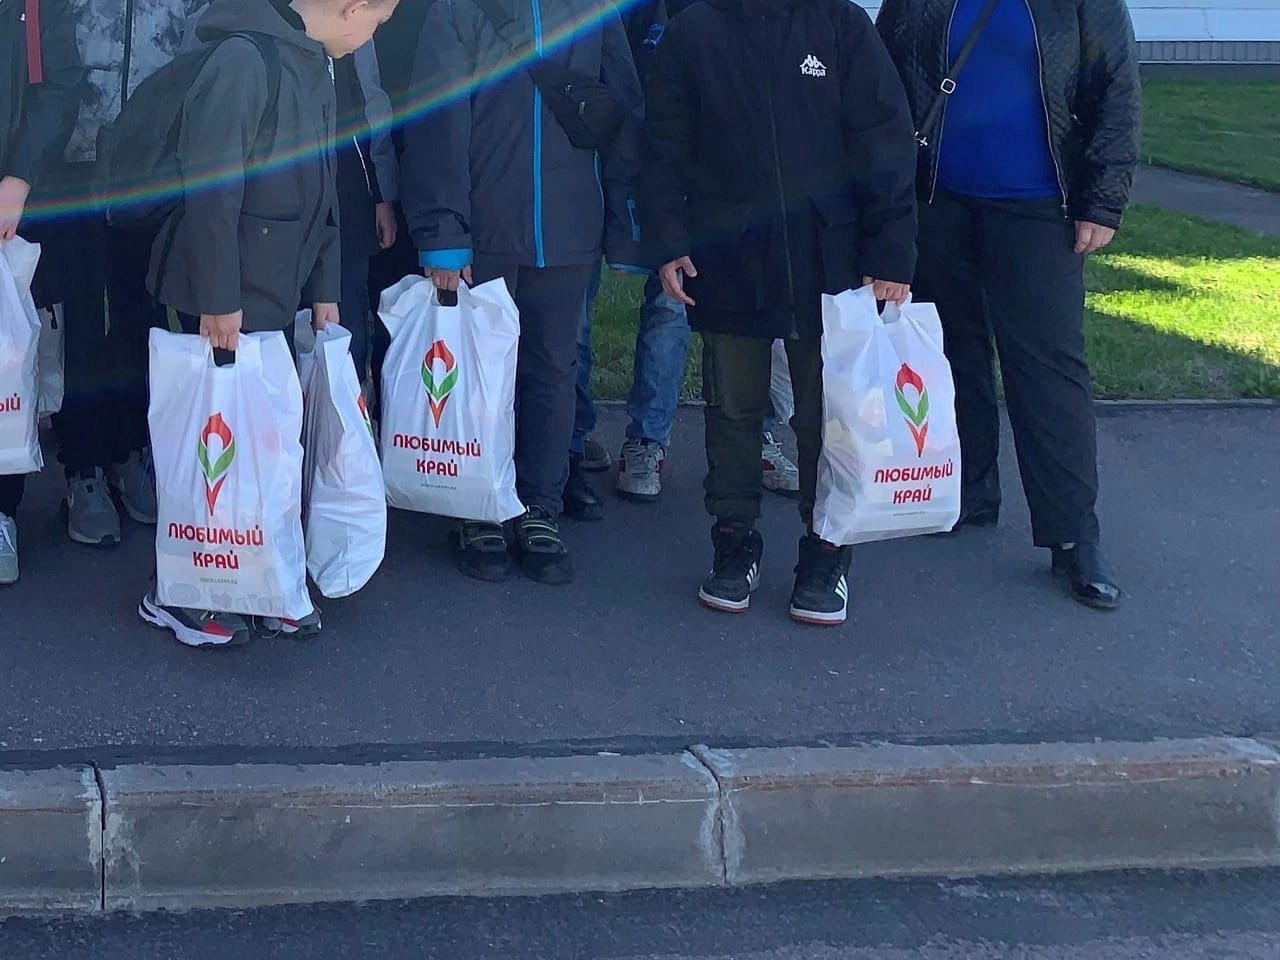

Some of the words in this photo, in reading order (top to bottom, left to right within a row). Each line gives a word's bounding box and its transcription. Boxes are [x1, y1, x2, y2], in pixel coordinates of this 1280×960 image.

[801, 66, 826, 77] Kappa
[393, 434, 481, 457] ЛЮБИМЫЙ
[416, 459, 458, 477] КРАЙ
[874, 458, 953, 483] ЛЮБИМЫЙ
[893, 484, 932, 505] КРАЙ
[168, 522, 264, 546] ЛЮБИМЫЙ
[193, 550, 239, 569] КРАЙ
